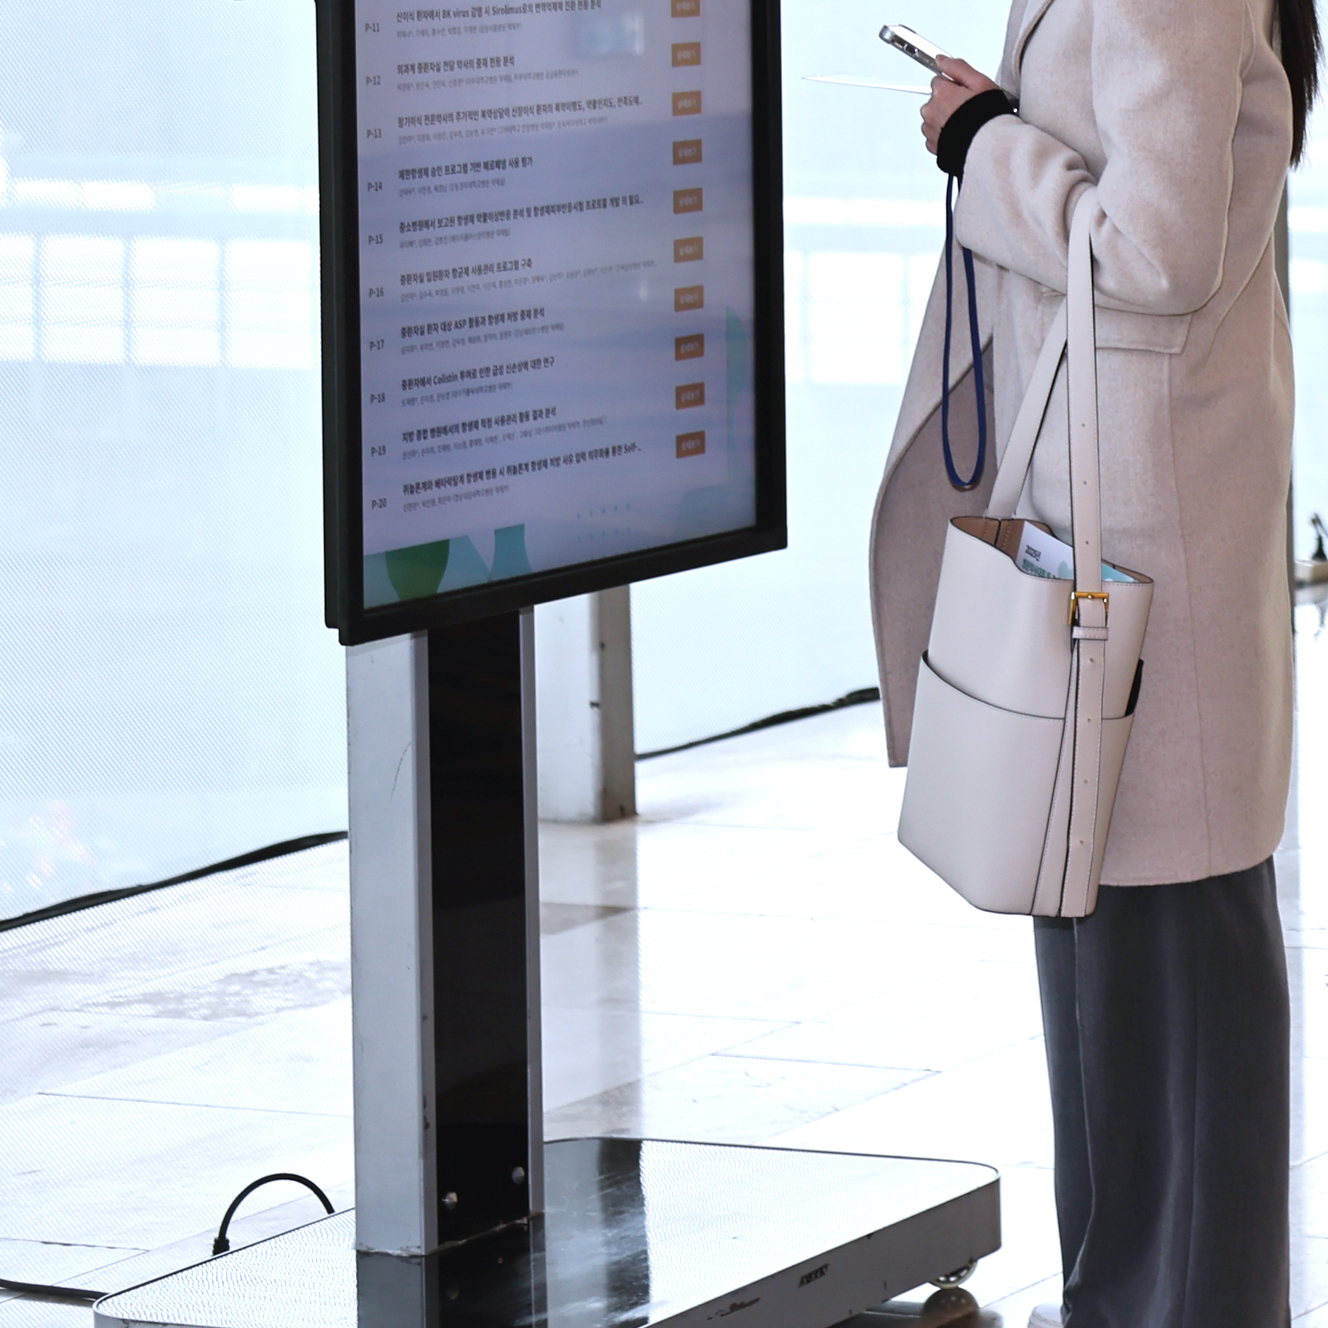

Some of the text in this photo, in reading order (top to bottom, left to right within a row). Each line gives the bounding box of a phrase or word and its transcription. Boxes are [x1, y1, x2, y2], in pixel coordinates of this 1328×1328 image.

[365, 23, 380, 32] P-11
[366, 76, 380, 85] P-12
[367, 129, 381, 138] P-13
[368, 182, 382, 191] P-14
[368, 234, 383, 244] P-15
[369, 287, 384, 298] P-16
[369, 339, 384, 350] P-17
[370, 393, 385, 403] P-18
[432, 372, 458, 386] Colistin
[371, 446, 386, 456] P-19
[372, 498, 387, 509] P-20
